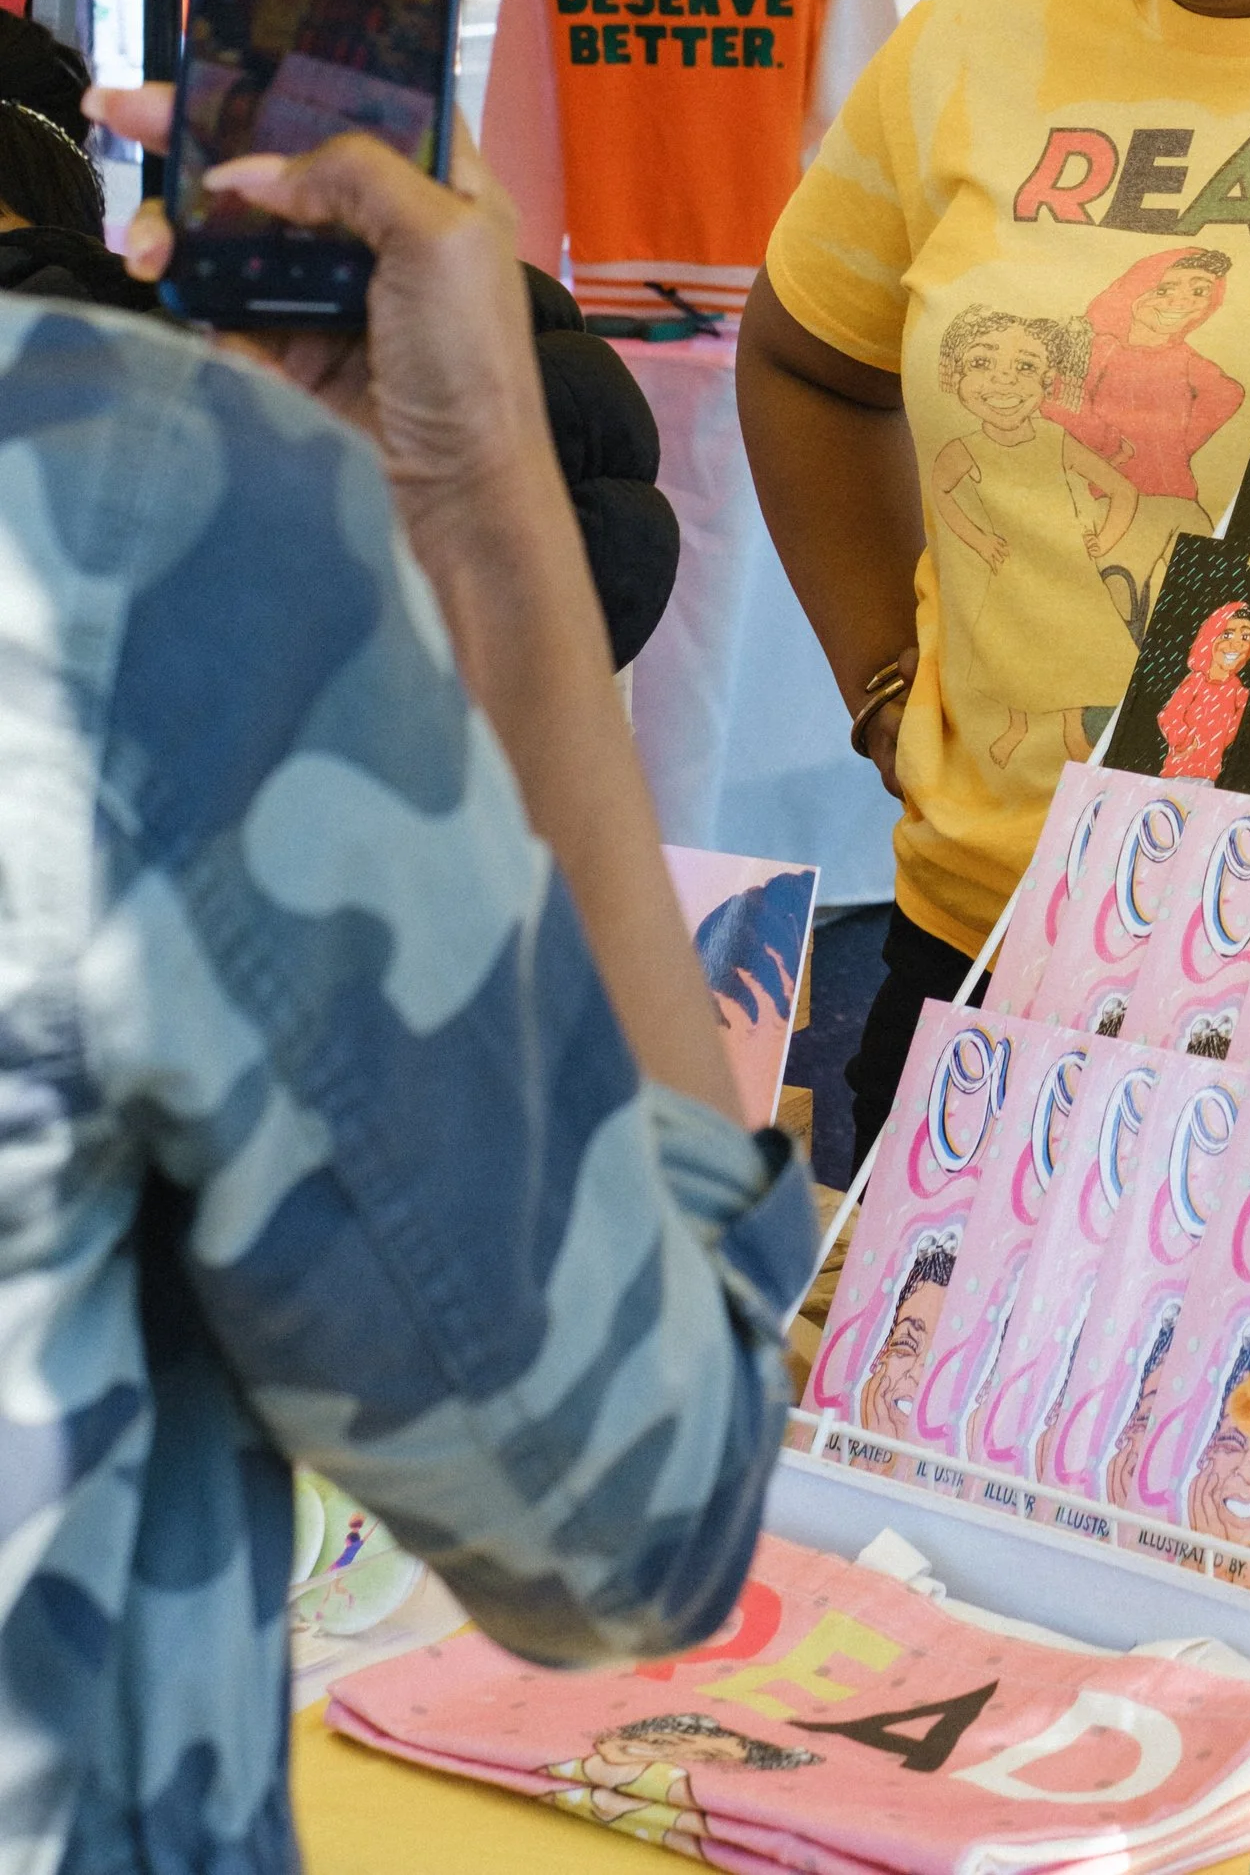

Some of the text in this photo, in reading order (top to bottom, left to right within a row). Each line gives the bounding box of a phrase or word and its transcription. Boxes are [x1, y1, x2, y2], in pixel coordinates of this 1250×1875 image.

[569, 24, 784, 68] BETTER.
[1055, 1506, 1110, 1537] ILLUSTR
[1138, 1529, 1224, 1568] ILLUSTRATD
